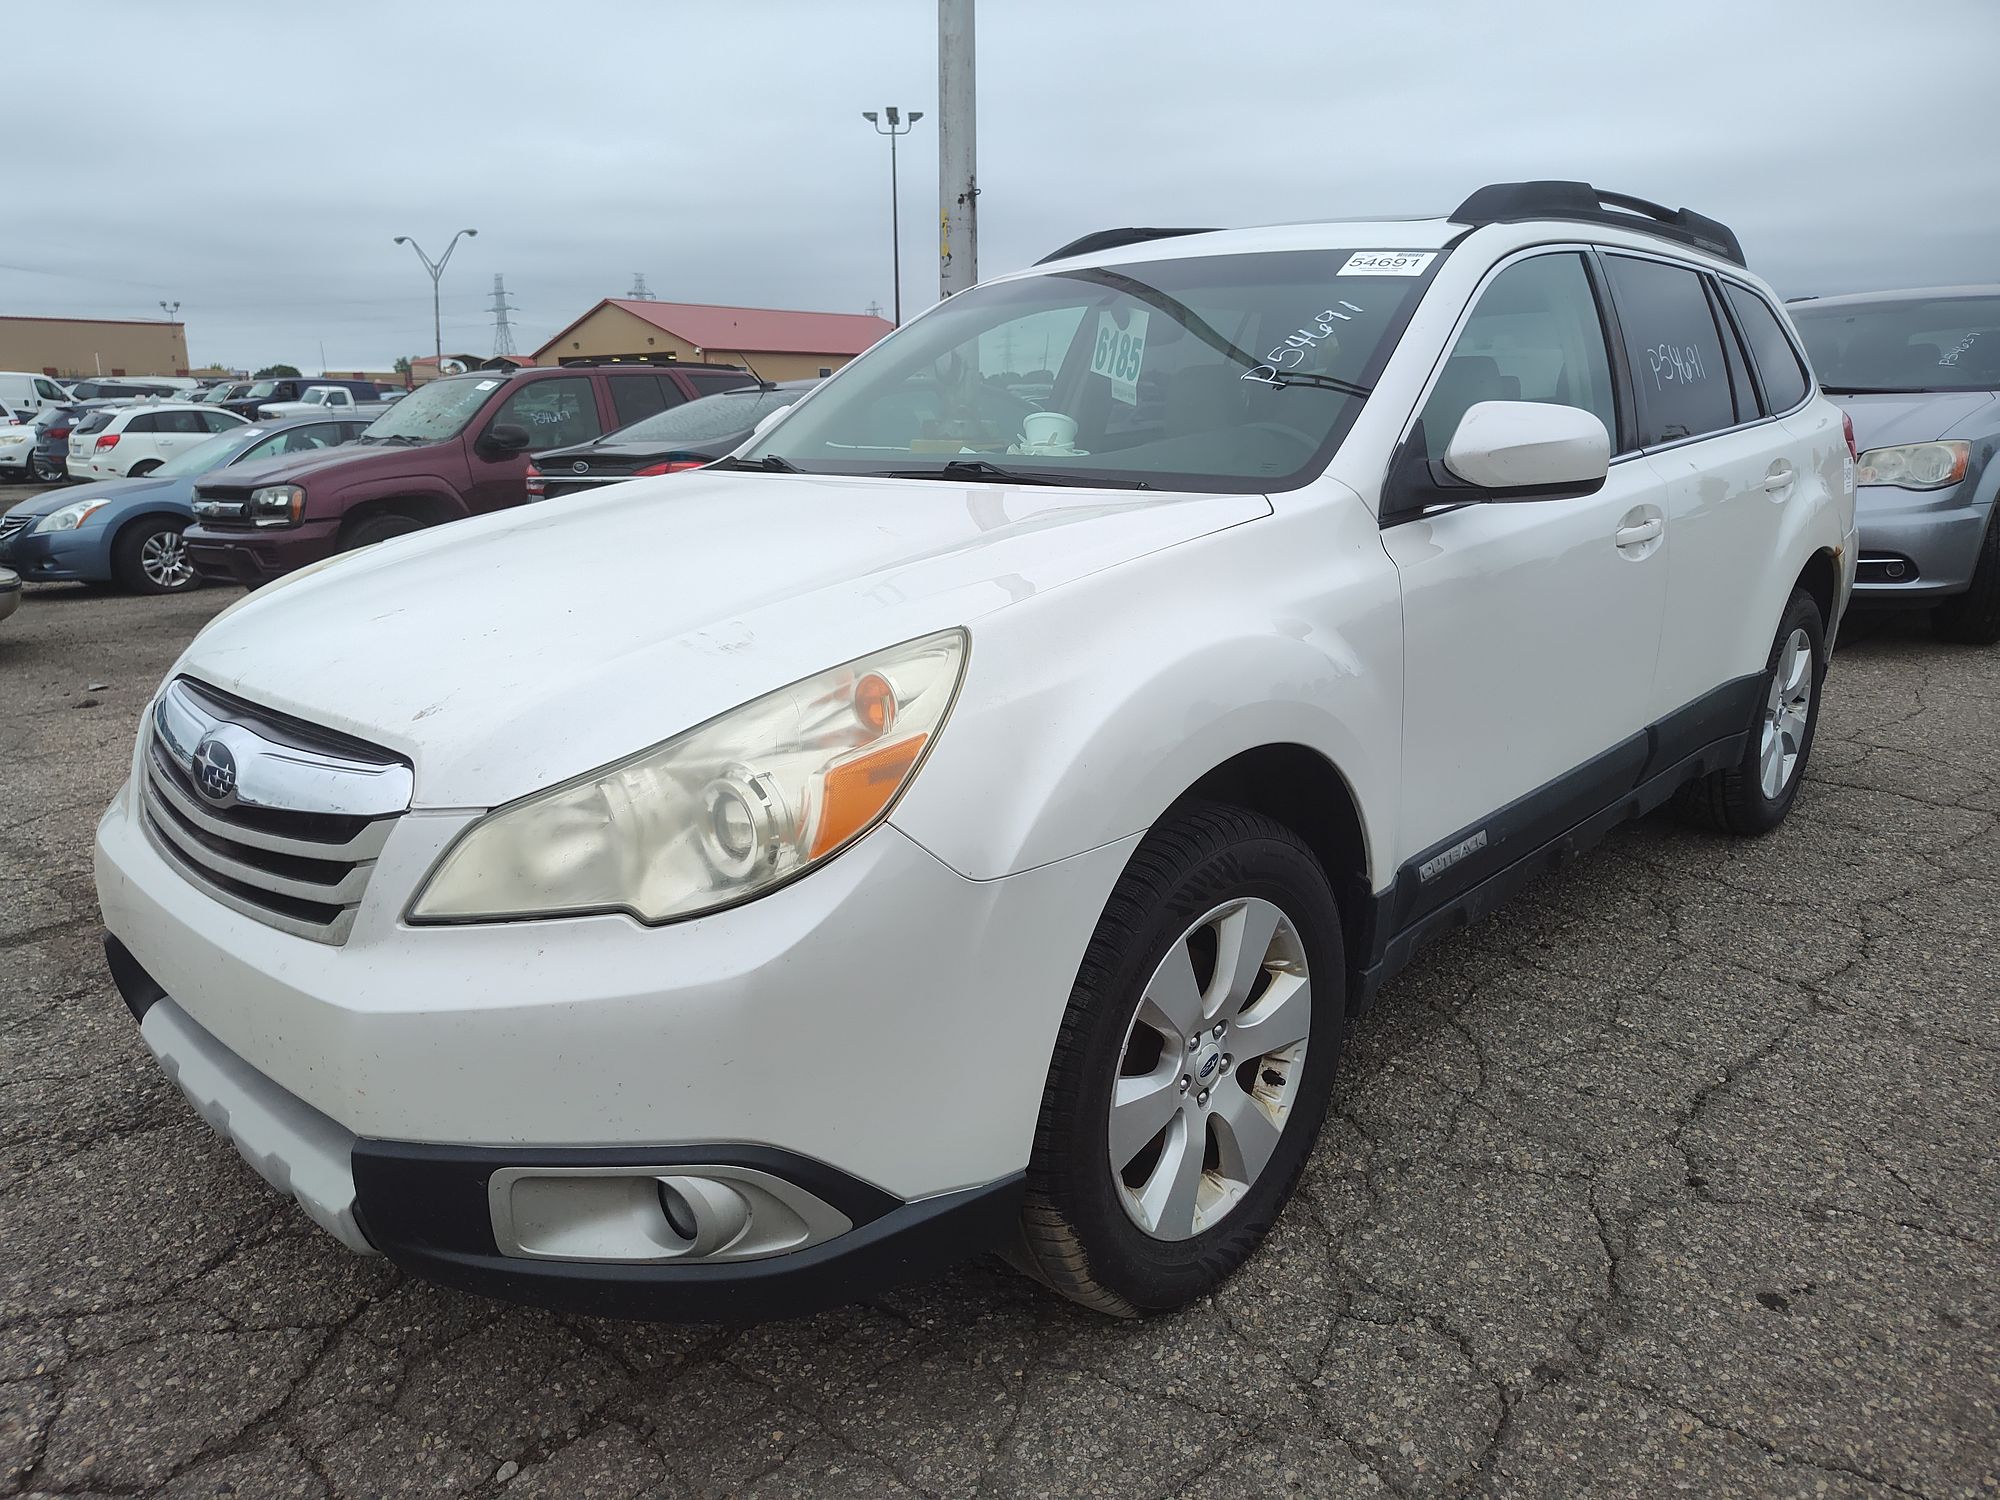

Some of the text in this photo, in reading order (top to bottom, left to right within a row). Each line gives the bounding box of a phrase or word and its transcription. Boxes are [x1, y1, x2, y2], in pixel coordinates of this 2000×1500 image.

[1349, 257, 1421, 268] 54691
[1095, 327, 1144, 381] 6185
[1241, 300, 1364, 386] P54691
[1647, 343, 1706, 392] P54691
